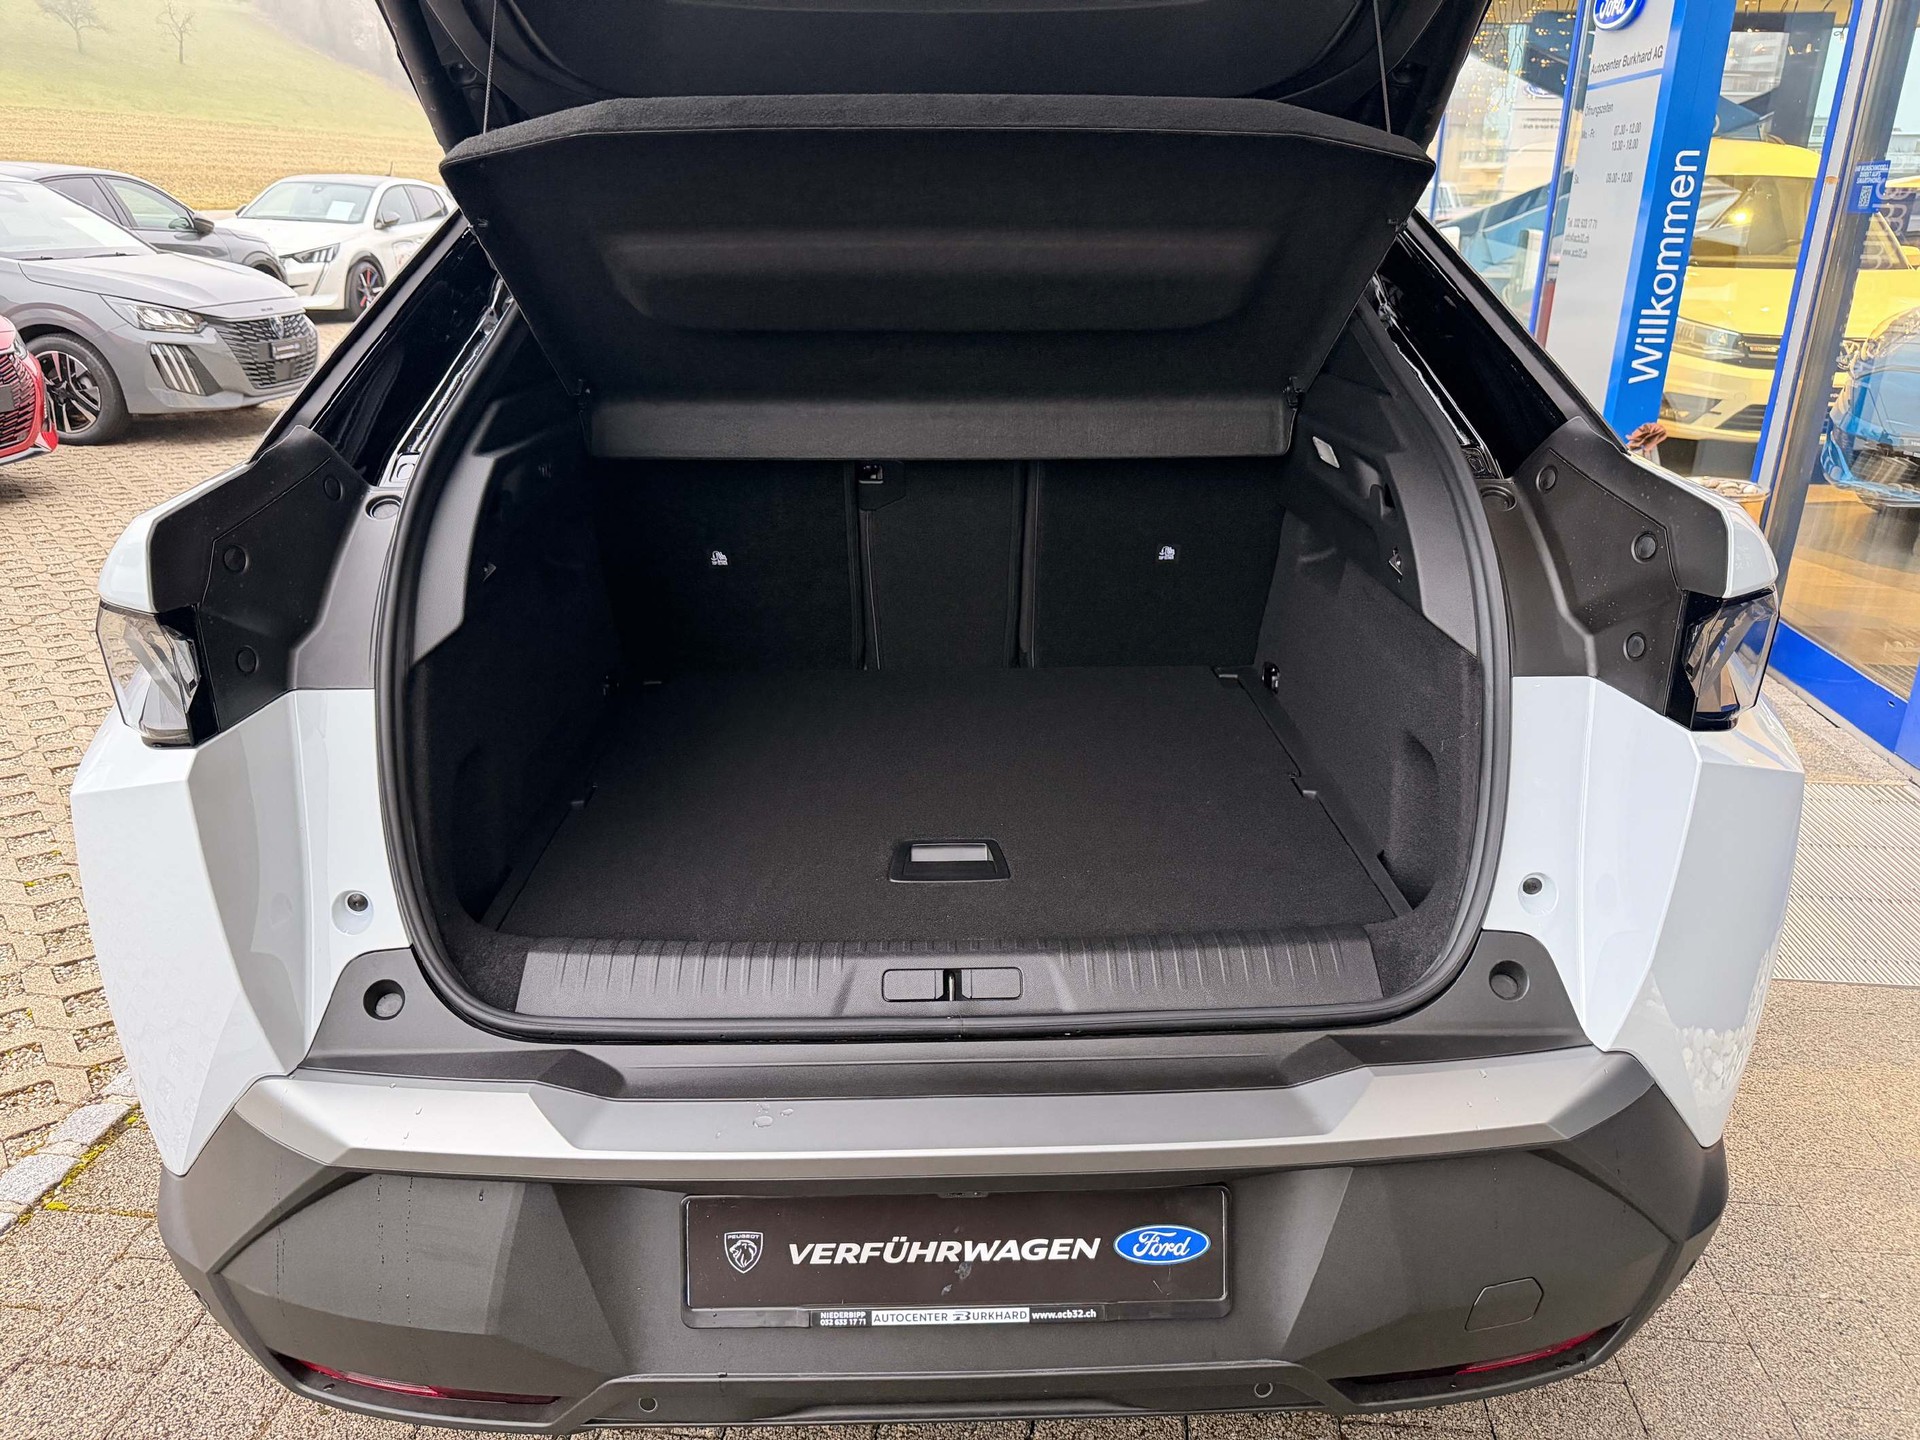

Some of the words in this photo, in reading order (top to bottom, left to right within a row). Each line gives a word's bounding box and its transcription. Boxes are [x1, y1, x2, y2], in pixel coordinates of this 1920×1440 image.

[1590, 57, 1622, 75] Autocenter
[1622, 48, 1652, 68] Burkhard
[1652, 45, 1664, 60] AG
[1628, 149, 1701, 384] Willkommen
[788, 1236, 1101, 1265] VERFÜHRWAGEN
[1132, 1231, 1191, 1258] Ford
[820, 1311, 866, 1319] NIEDERBIPP
[820, 1318, 833, 1326] 032
[834, 1318, 847, 1326] 633
[849, 1318, 857, 1326] 17
[858, 1317, 866, 1325] 71
[873, 1312, 948, 1323] AUTOCENTER
[953, 1310, 1028, 1322] BURKHARD
[1031, 1309, 1097, 1320] www.acb32.ch
